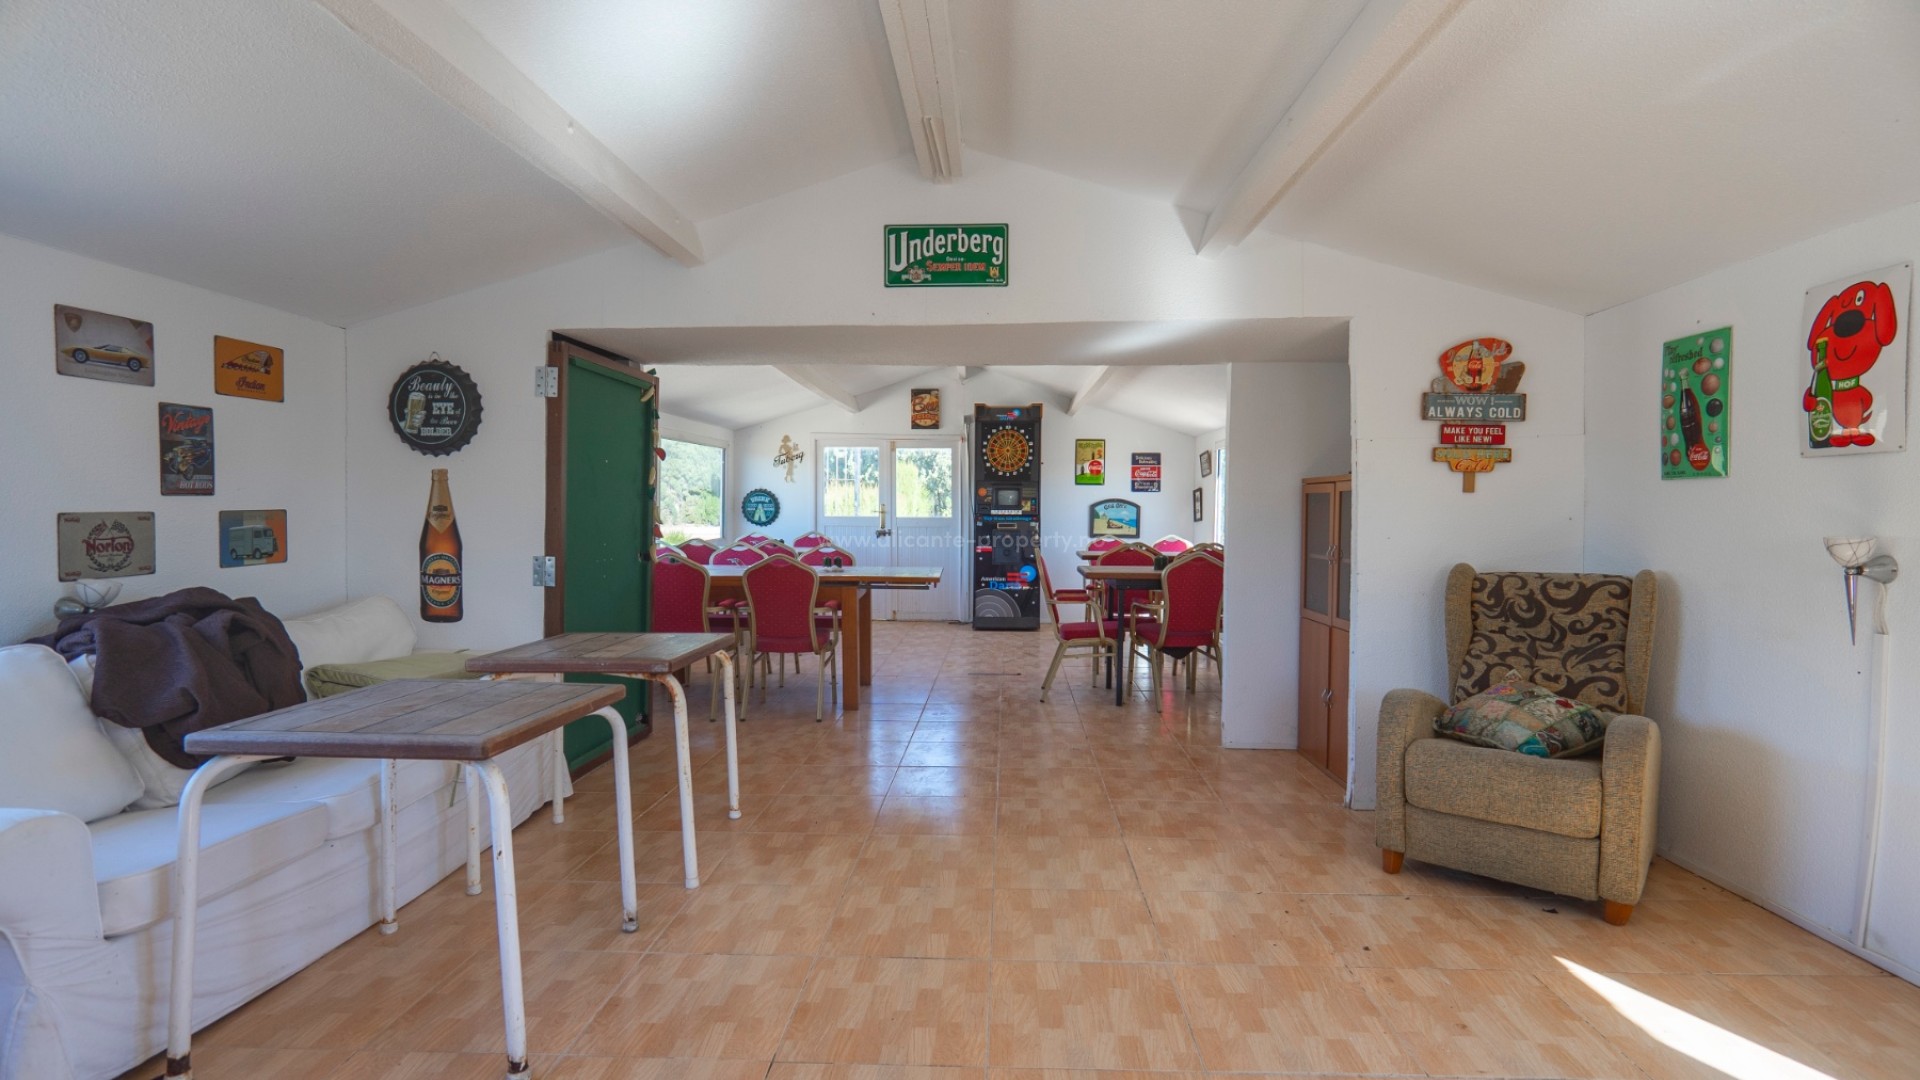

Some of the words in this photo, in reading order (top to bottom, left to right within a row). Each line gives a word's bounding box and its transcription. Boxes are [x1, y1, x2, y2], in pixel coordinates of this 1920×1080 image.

[888, 228, 1004, 272] Underberg
[407, 375, 454, 398] Beauty
[1838, 379, 1856, 389] HOF
[432, 402, 455, 415] EYE
[1428, 406, 1483, 418] ALWAYS
[1489, 407, 1521, 419] COLD
[161, 410, 211, 434] Vintage
[420, 426, 453, 437] HOLDER
[1443, 426, 1466, 435] MAKE
[1468, 426, 1484, 435] YOU
[1485, 427, 1504, 435] FEEL
[1454, 436, 1471, 444] LIKE
[1472, 436, 1493, 444] NEW!
[82, 537, 134, 556] Norton
[421, 574, 461, 585] MAGNERS
